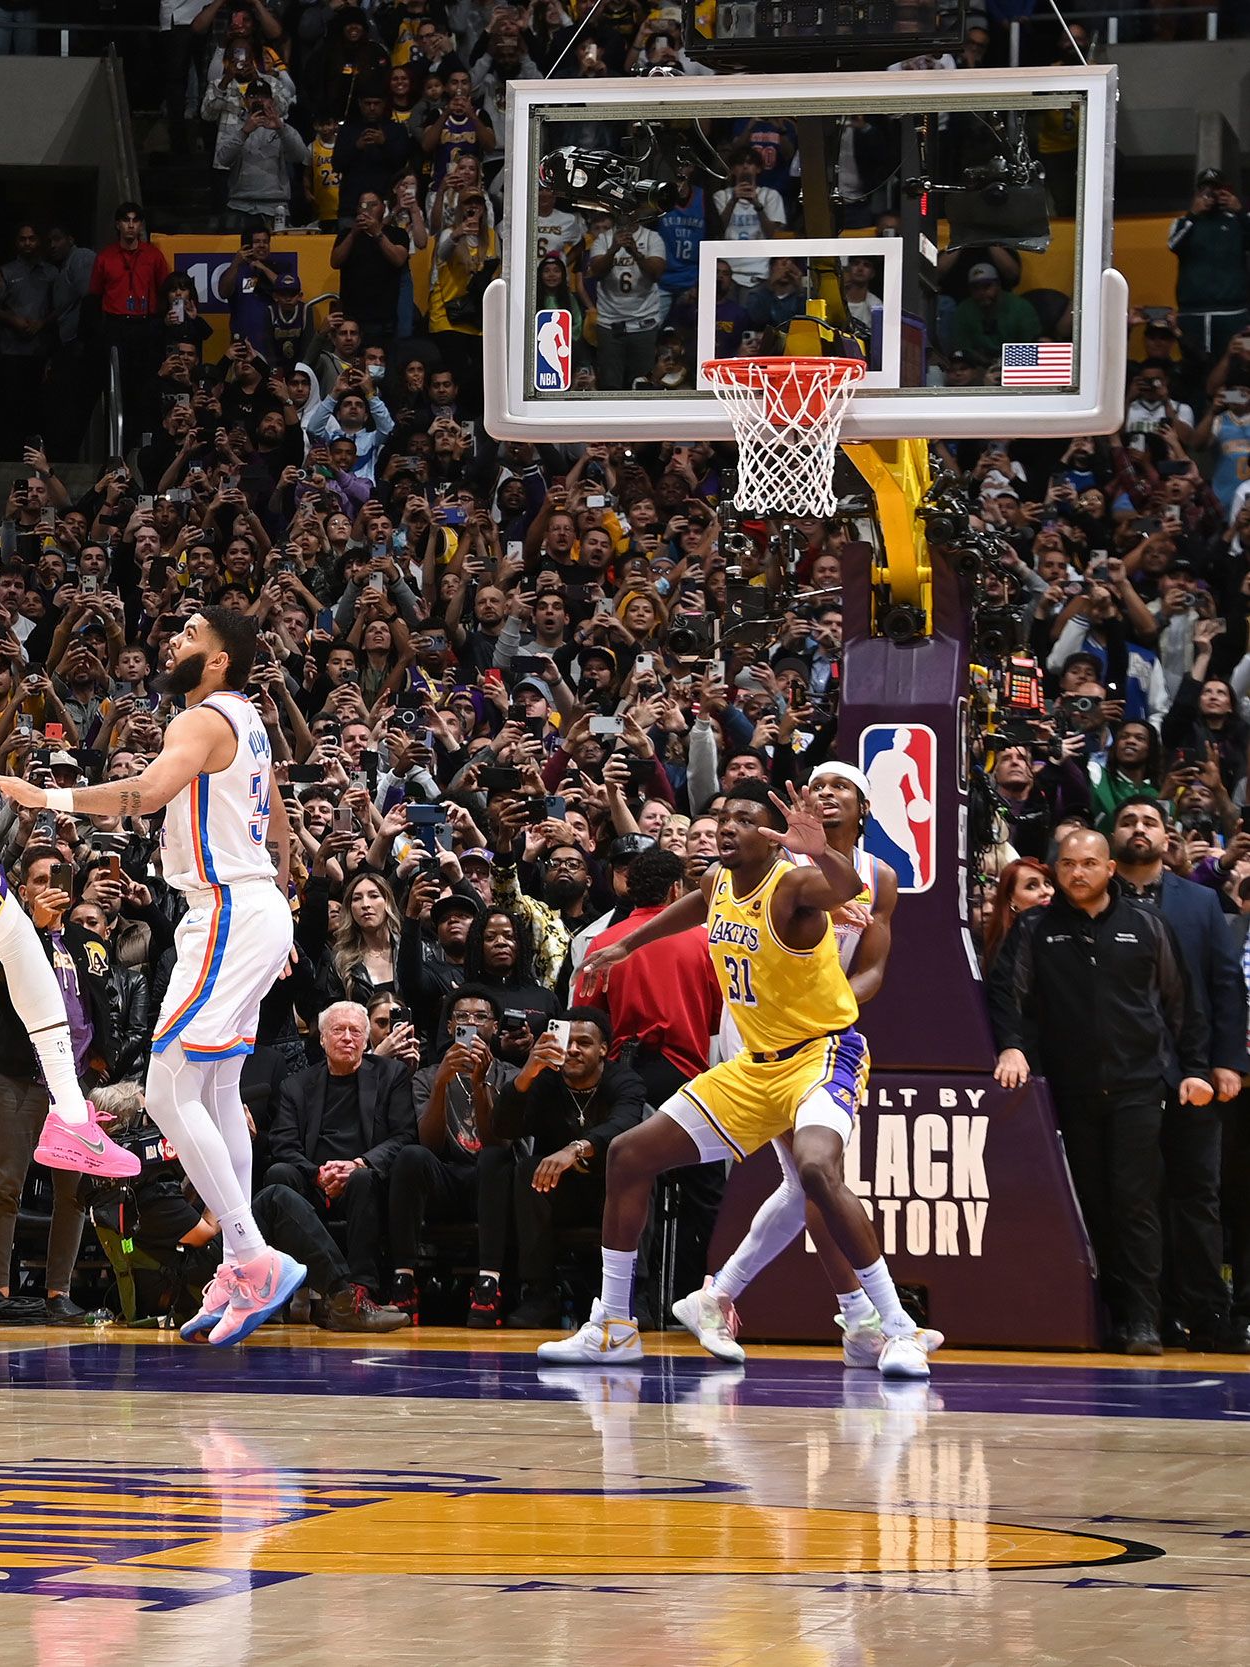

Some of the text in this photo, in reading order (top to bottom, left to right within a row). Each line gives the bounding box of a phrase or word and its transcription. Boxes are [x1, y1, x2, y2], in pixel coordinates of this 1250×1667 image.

[538, 237, 549, 259] 6
[675, 240, 693, 260] 12
[620, 271, 633, 293] 6
[539, 372, 557, 386] NBA
[708, 914, 760, 952] LAKERS
[724, 955, 759, 1007] 31
[860, 1087, 986, 1109] ILT BY
[843, 1113, 990, 1200] LACK
